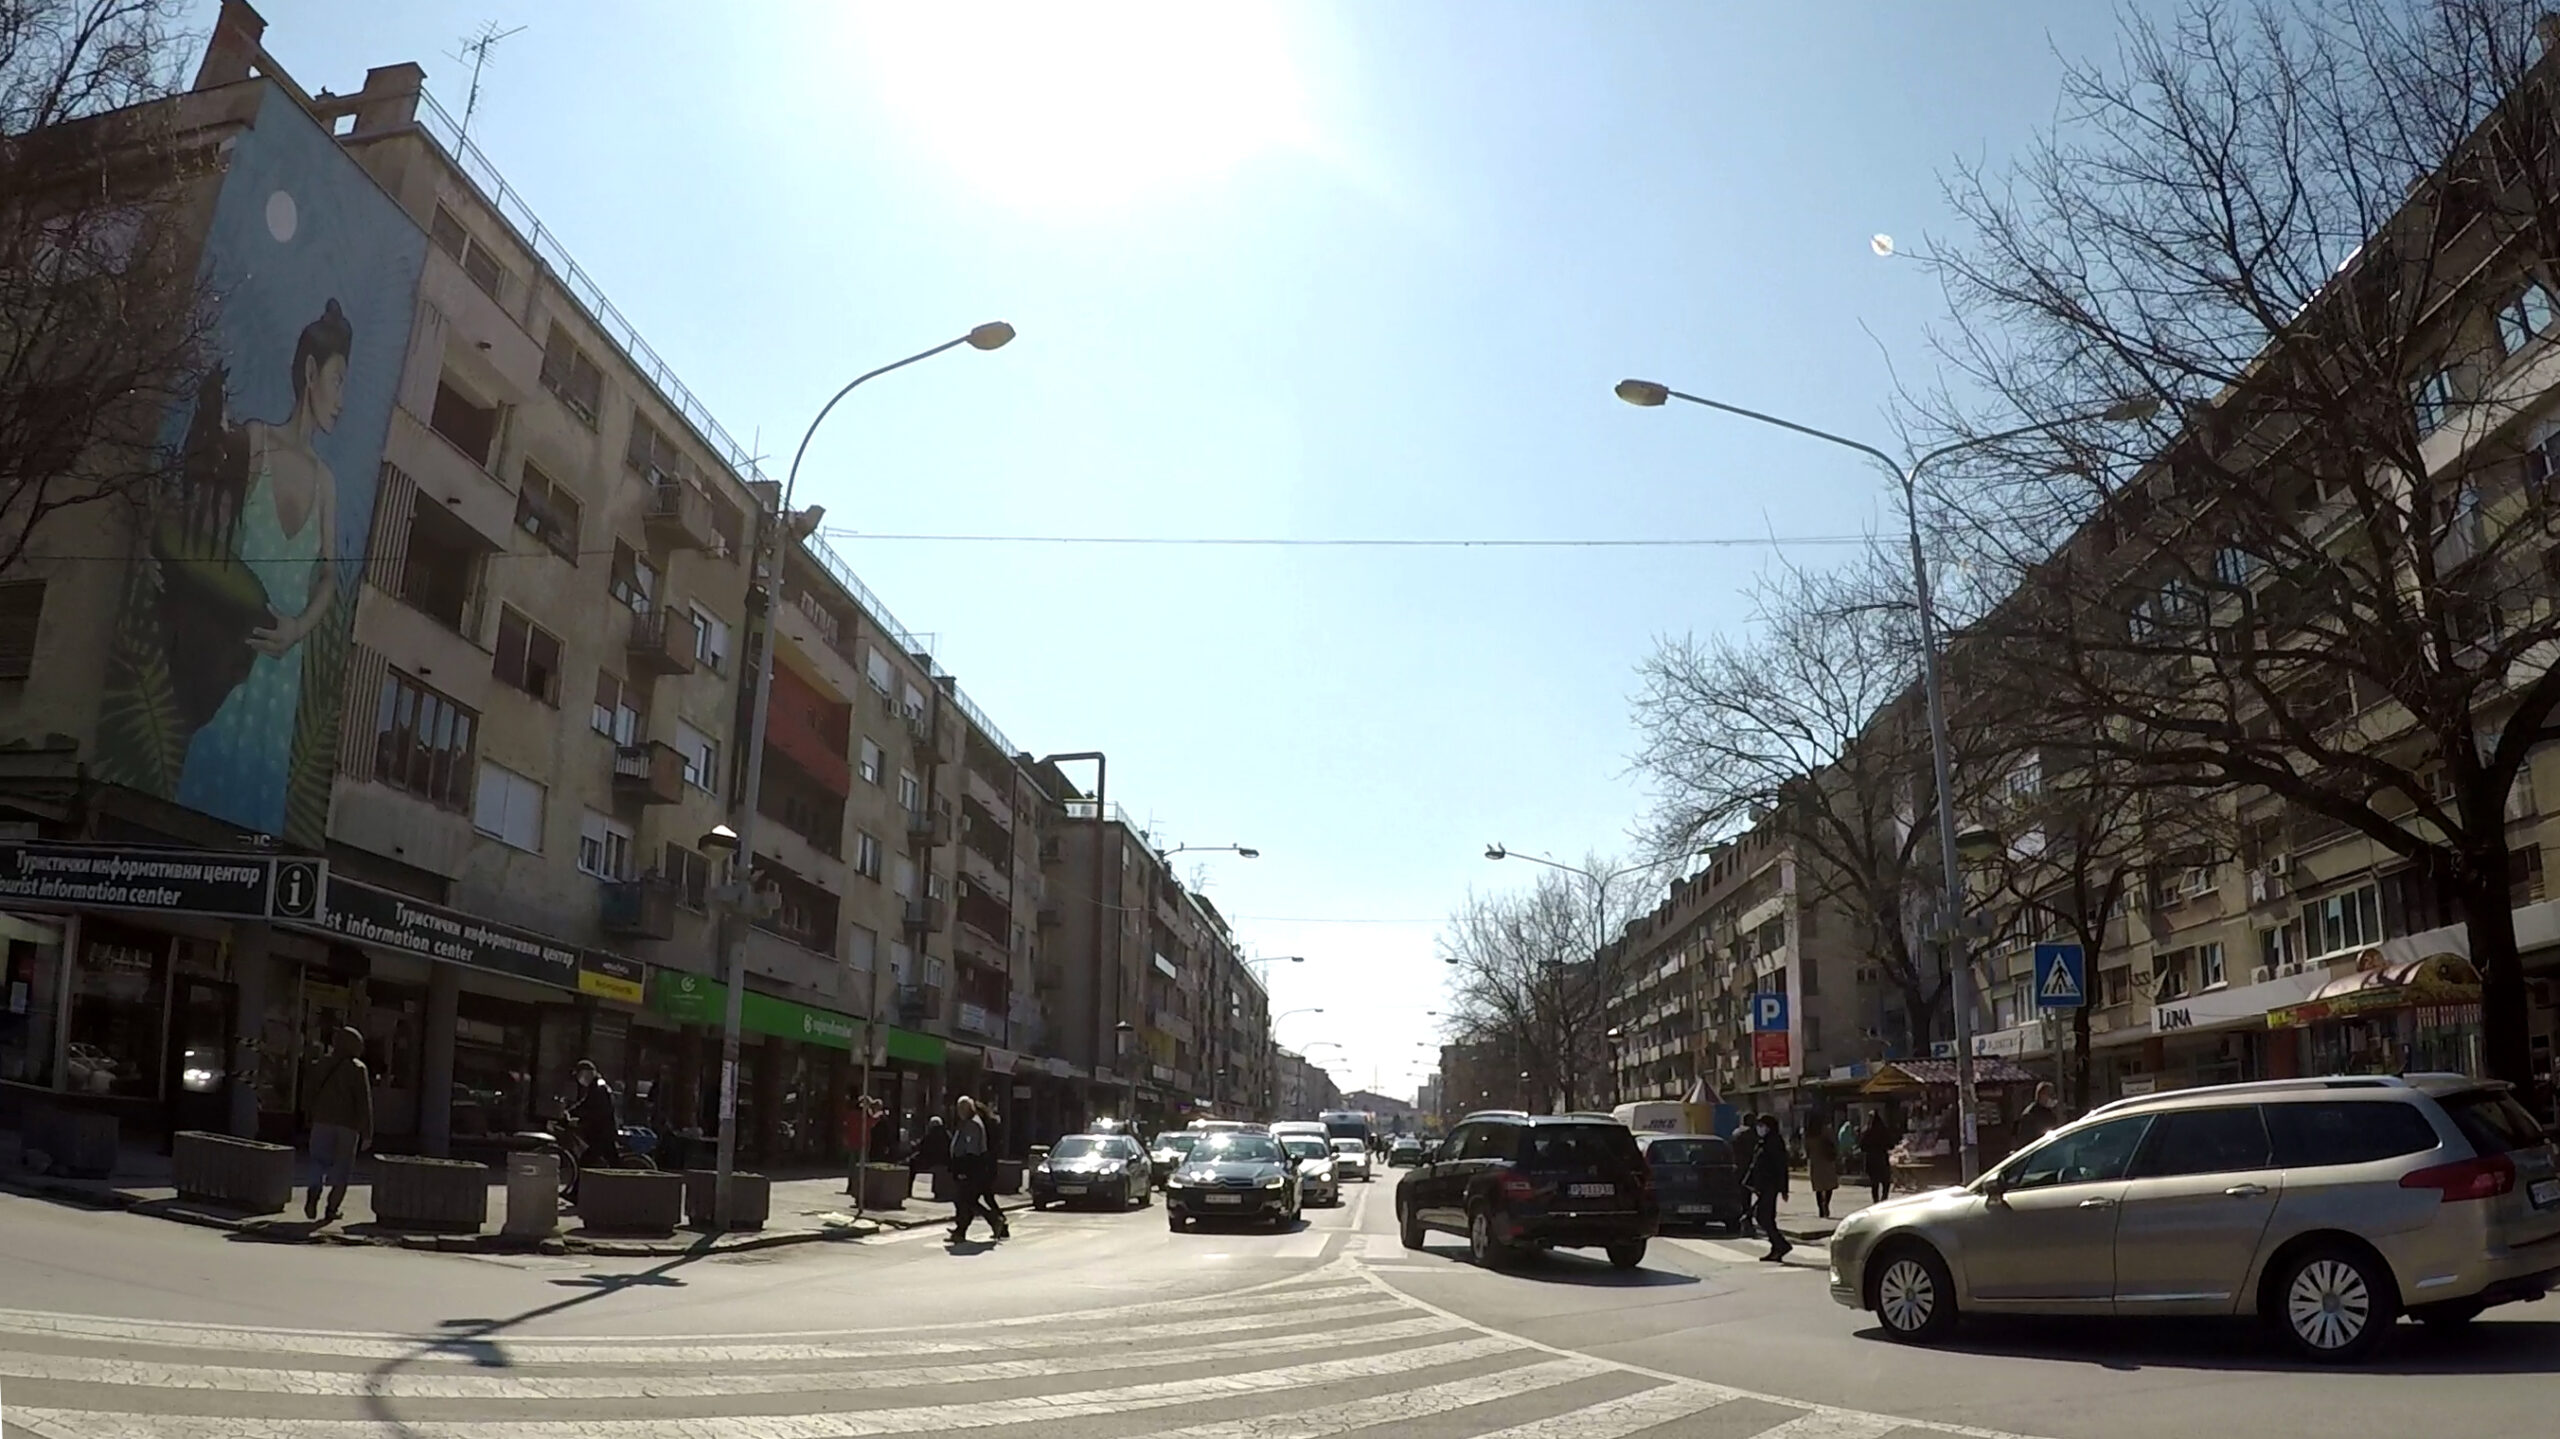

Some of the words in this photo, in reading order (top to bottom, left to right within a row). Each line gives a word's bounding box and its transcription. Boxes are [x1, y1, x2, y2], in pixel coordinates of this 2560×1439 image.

[16, 850, 89, 874] Туристички
[91, 857, 201, 881] информативни
[203, 863, 260, 888] центар
[0, 874, 39, 895] ourist
[40, 876, 126, 902] information
[128, 885, 181, 906] center
[345, 913, 430, 952] information
[432, 938, 474, 963] center
[395, 901, 461, 934] Туристички
[463, 922, 540, 957] информативни
[1760, 998, 1781, 1026] P
[2158, 1007, 2193, 1031] LUNA
